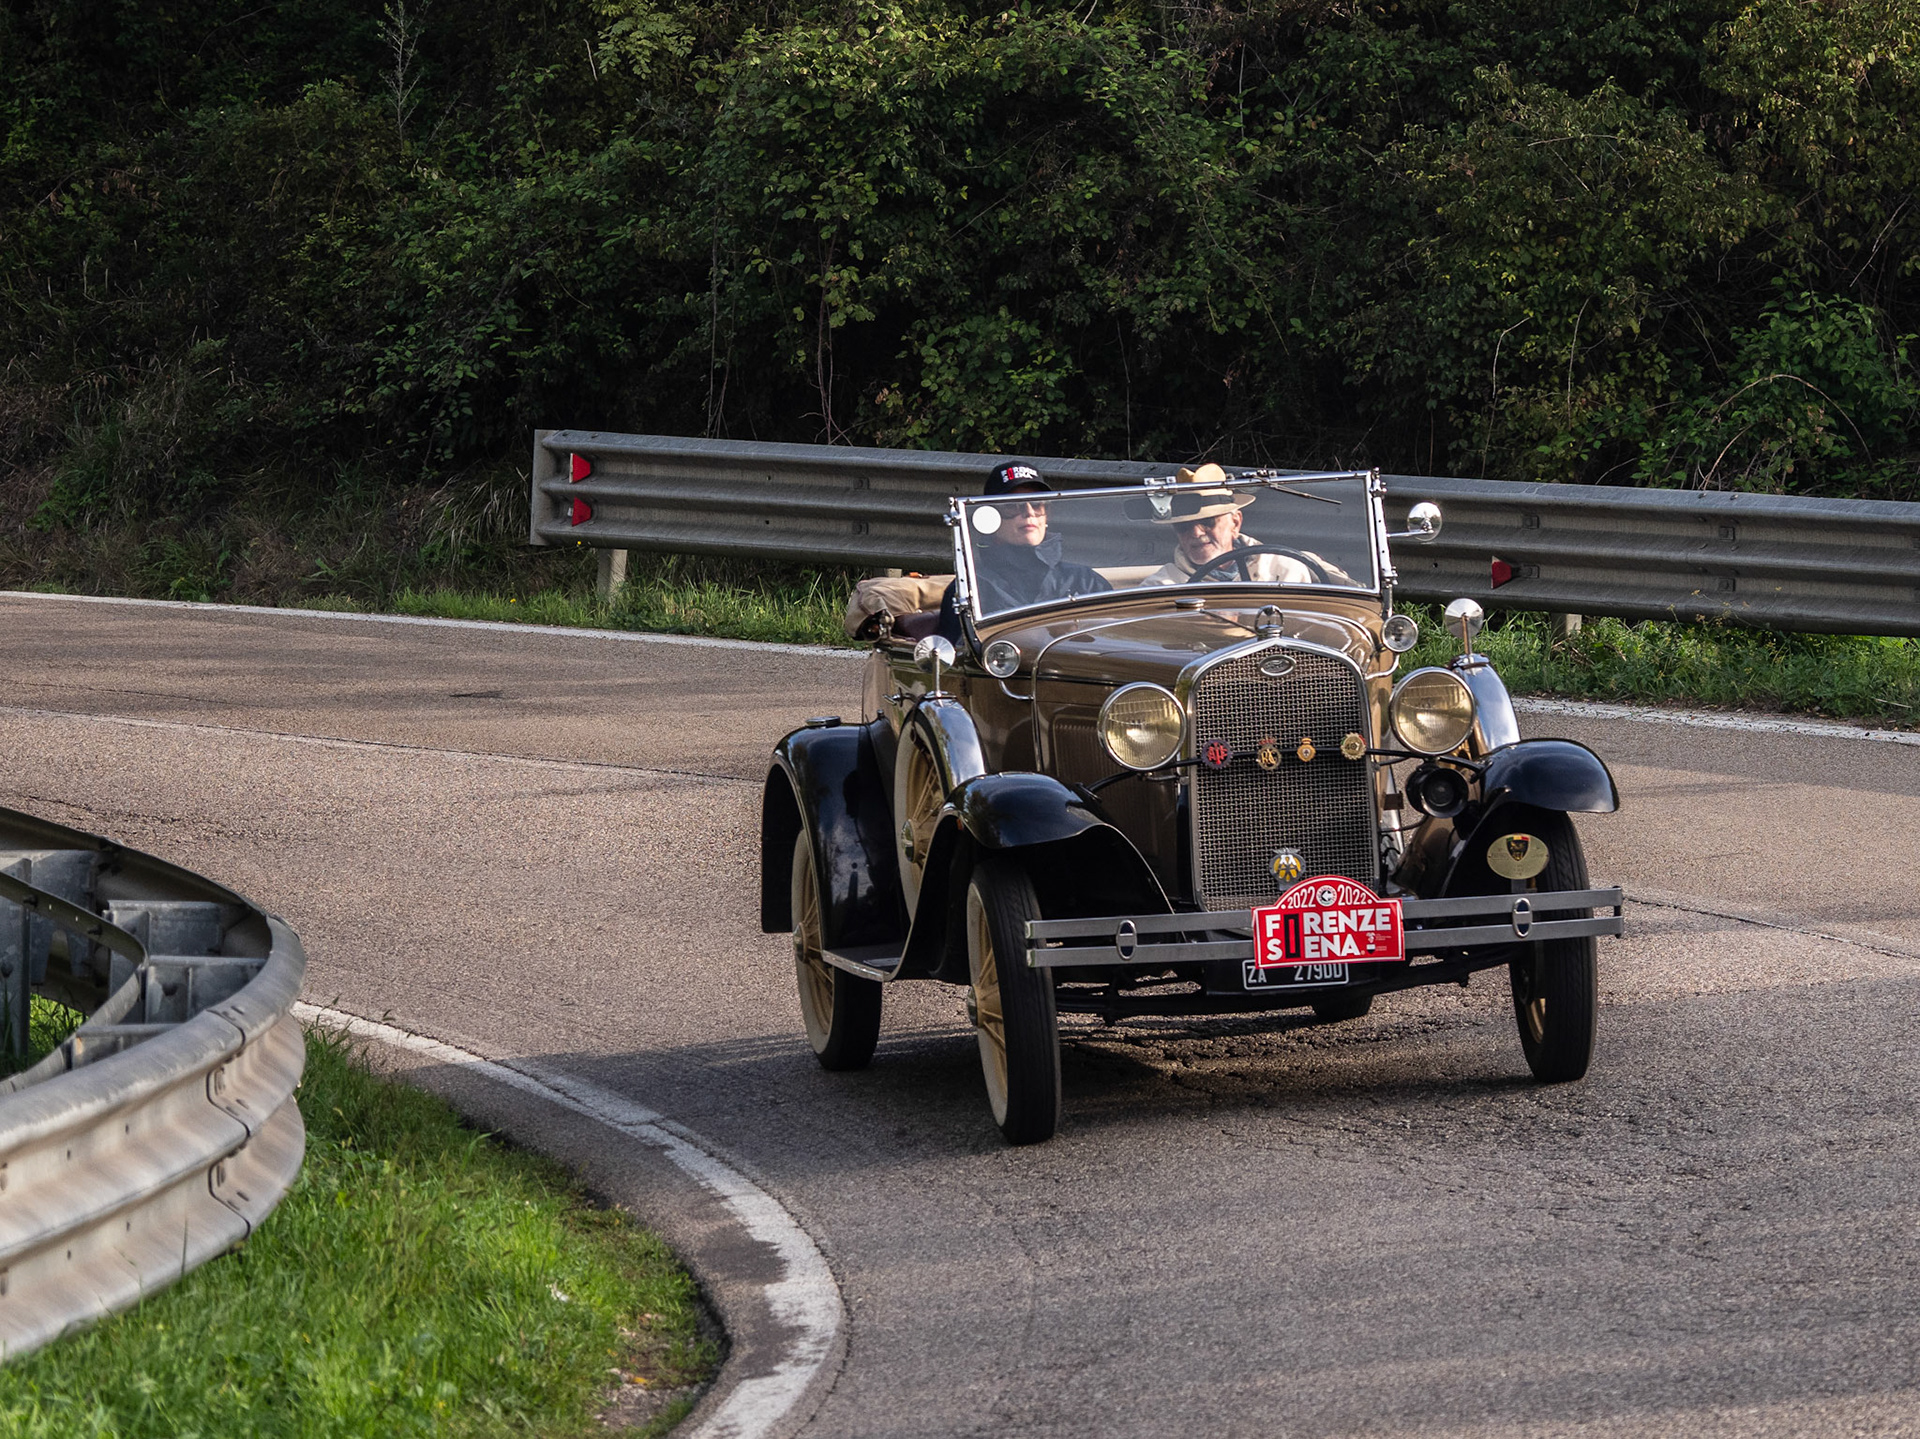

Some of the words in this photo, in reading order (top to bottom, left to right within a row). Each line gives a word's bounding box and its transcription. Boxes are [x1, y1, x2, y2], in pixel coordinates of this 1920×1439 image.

[1287, 886, 1316, 909] 2022
[1337, 884, 1366, 906] 2022
[1265, 908, 1392, 940] FIRENZE
[1246, 965, 1267, 984] ZA
